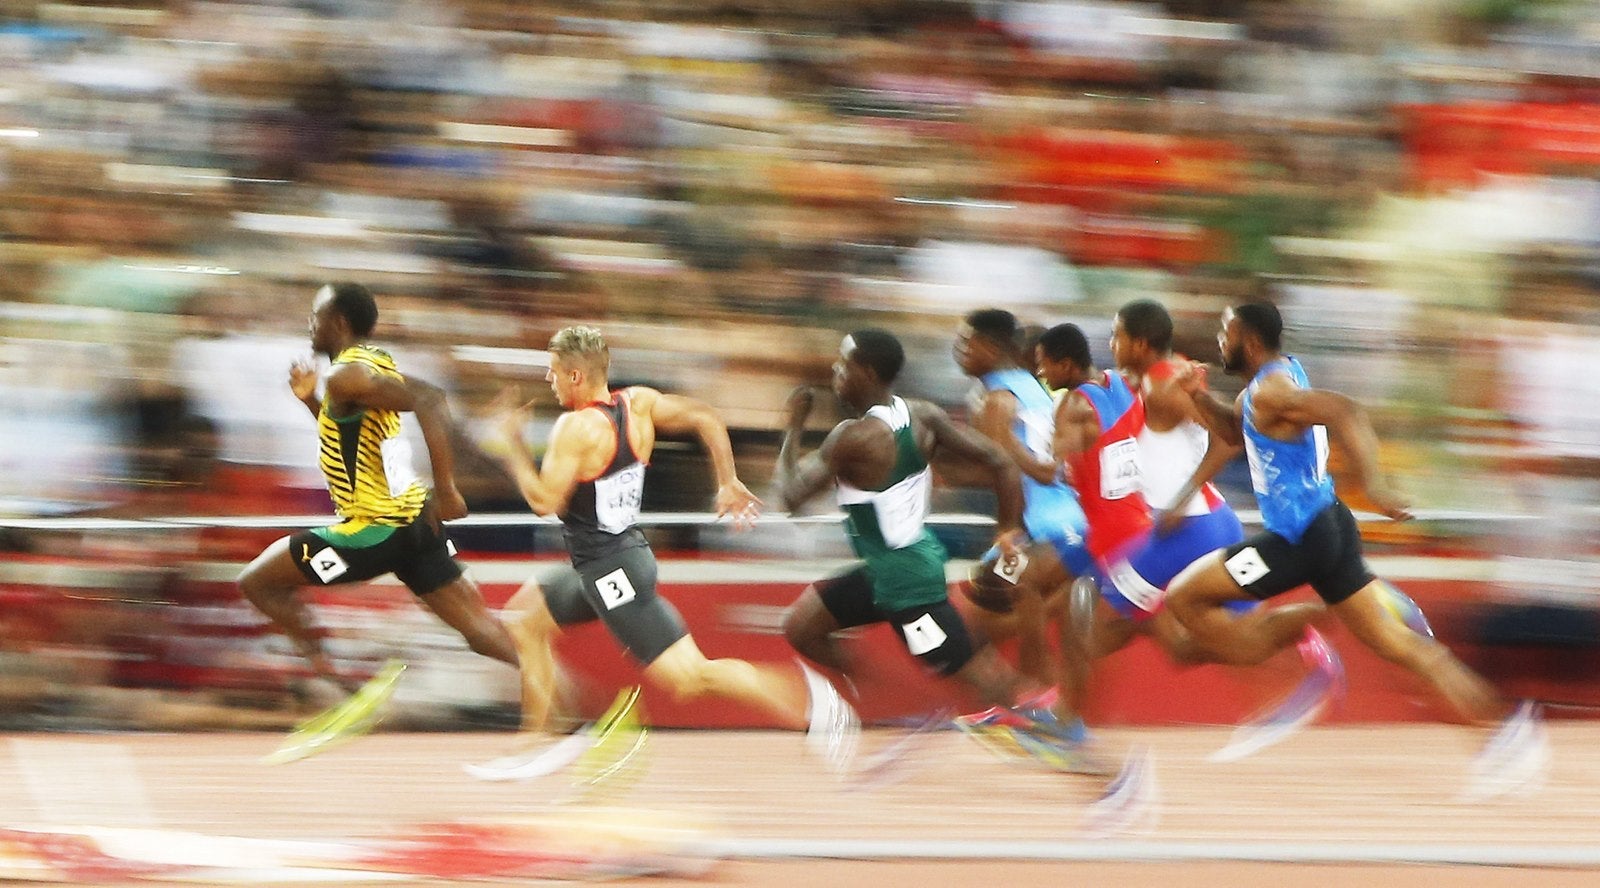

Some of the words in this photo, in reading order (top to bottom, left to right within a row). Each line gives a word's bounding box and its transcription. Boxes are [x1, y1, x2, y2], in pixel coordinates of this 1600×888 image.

[321, 560, 337, 572] 4
[1002, 553, 1020, 576] 8
[607, 581, 624, 600] 3
